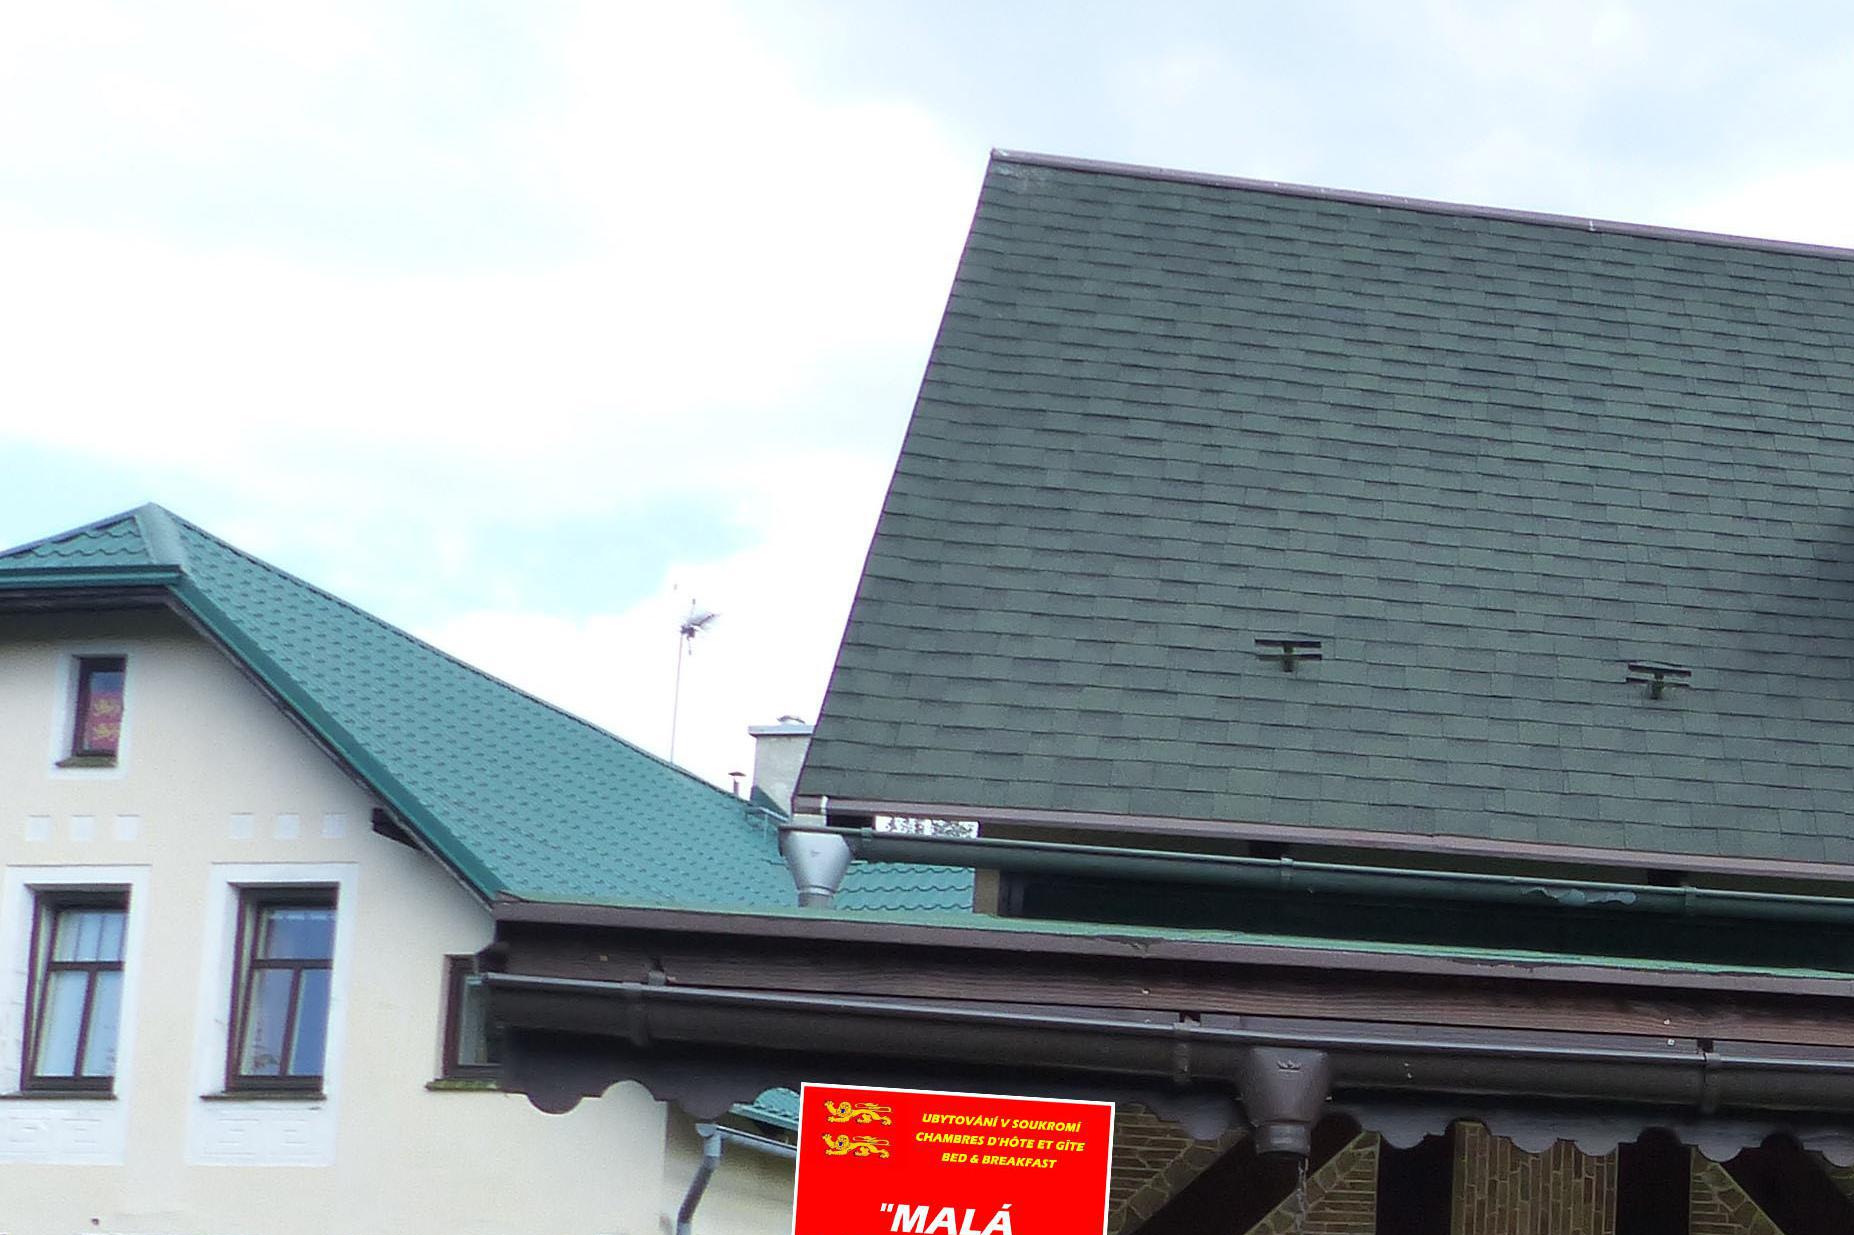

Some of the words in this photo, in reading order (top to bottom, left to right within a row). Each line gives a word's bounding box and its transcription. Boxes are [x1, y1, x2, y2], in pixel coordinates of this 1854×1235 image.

[922, 1113, 999, 1127] UBYTOVÁNÍ
[1000, 1118, 1010, 1128] V
[1012, 1119, 1082, 1133] SOUKROMÍ
[915, 1132, 985, 1146] CHAMBRES
[987, 1136, 1035, 1149] D'HÔTE
[1037, 1140, 1055, 1150] ET
[941, 1153, 968, 1163] BED
[969, 1154, 979, 1164] &
[982, 1155, 1058, 1169] BREAKFAST
